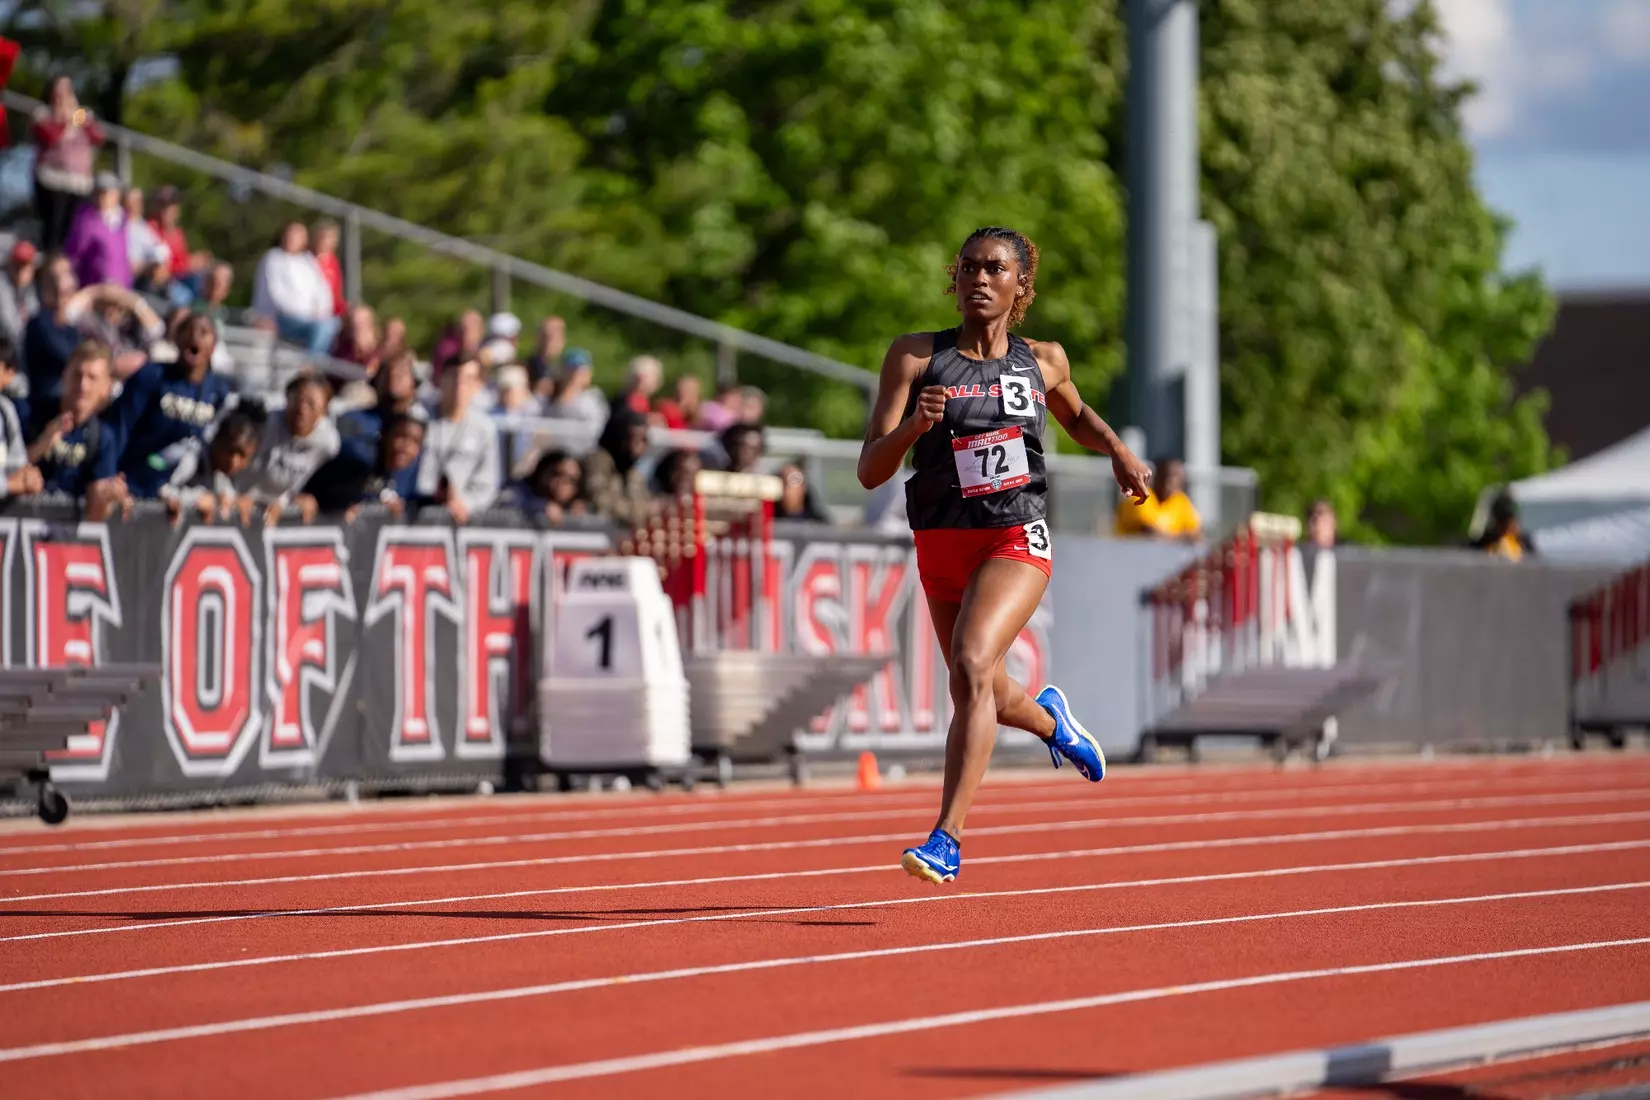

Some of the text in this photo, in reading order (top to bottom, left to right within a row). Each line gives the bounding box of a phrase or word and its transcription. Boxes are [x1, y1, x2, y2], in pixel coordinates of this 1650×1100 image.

[947, 384, 1046, 407] ALL STE
[1005, 382, 1029, 410] 3
[973, 445, 1009, 477] 72
[1031, 523, 1049, 551] 3
[162, 525, 358, 777] OF
[364, 525, 612, 761] TH
[586, 613, 613, 671] 1
